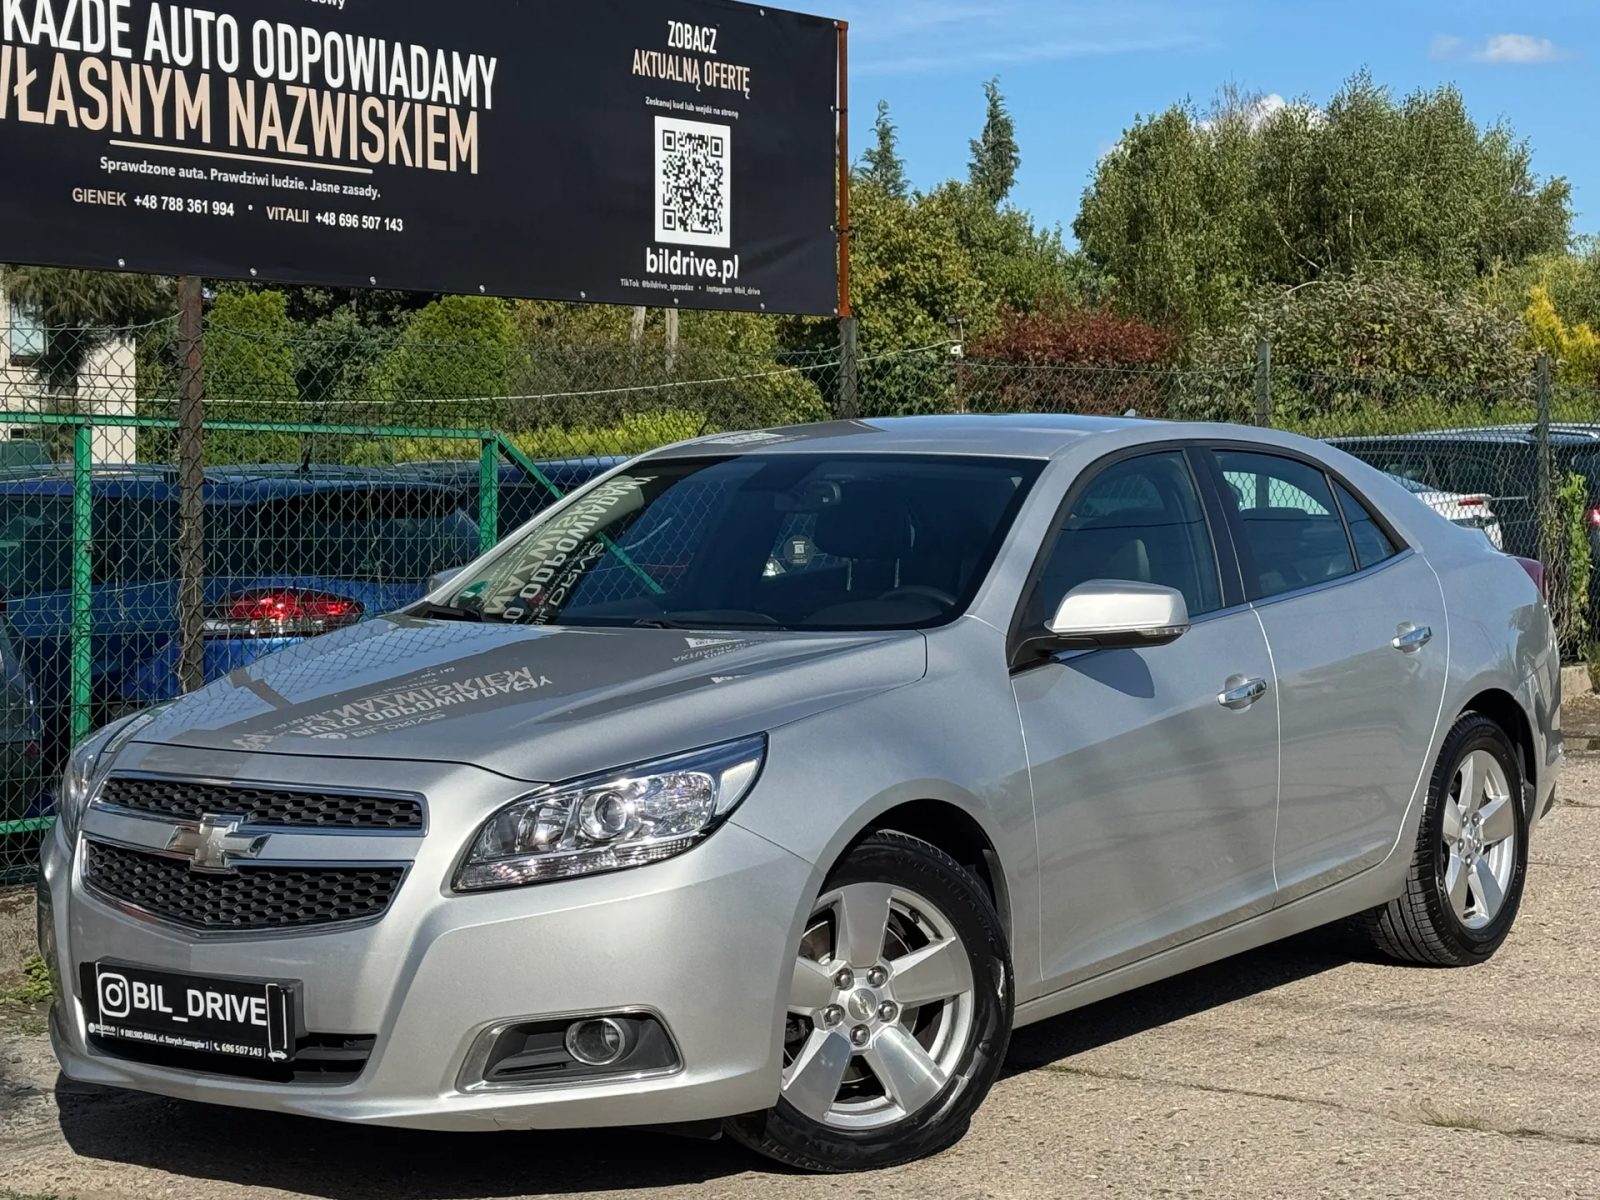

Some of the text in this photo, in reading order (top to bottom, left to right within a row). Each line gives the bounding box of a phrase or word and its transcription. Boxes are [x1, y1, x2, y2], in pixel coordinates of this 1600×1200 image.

[667, 20, 717, 54] ZOBACZ
[143, 2, 239, 73] AUTO
[252, 20, 497, 110] ODPOWIADAMY
[632, 49, 750, 99] AKTUALNĄ OFERTĘ
[228, 76, 478, 174] NAZWISKIEM
[100, 156, 381, 200] Sprawdzone auta. Prawdziwi ludzie. Jasne zasady.
[72, 187, 235, 216] GIENEK +48 788 361 994
[266, 206, 403, 232] VITALII +48 696 507 143
[620, 278, 640, 288] TikTok
[646, 248, 739, 284] bildrive.pl
[132, 981, 268, 1027] BIL_DRIVE
[221, 1043, 262, 1057] 696 507 143
